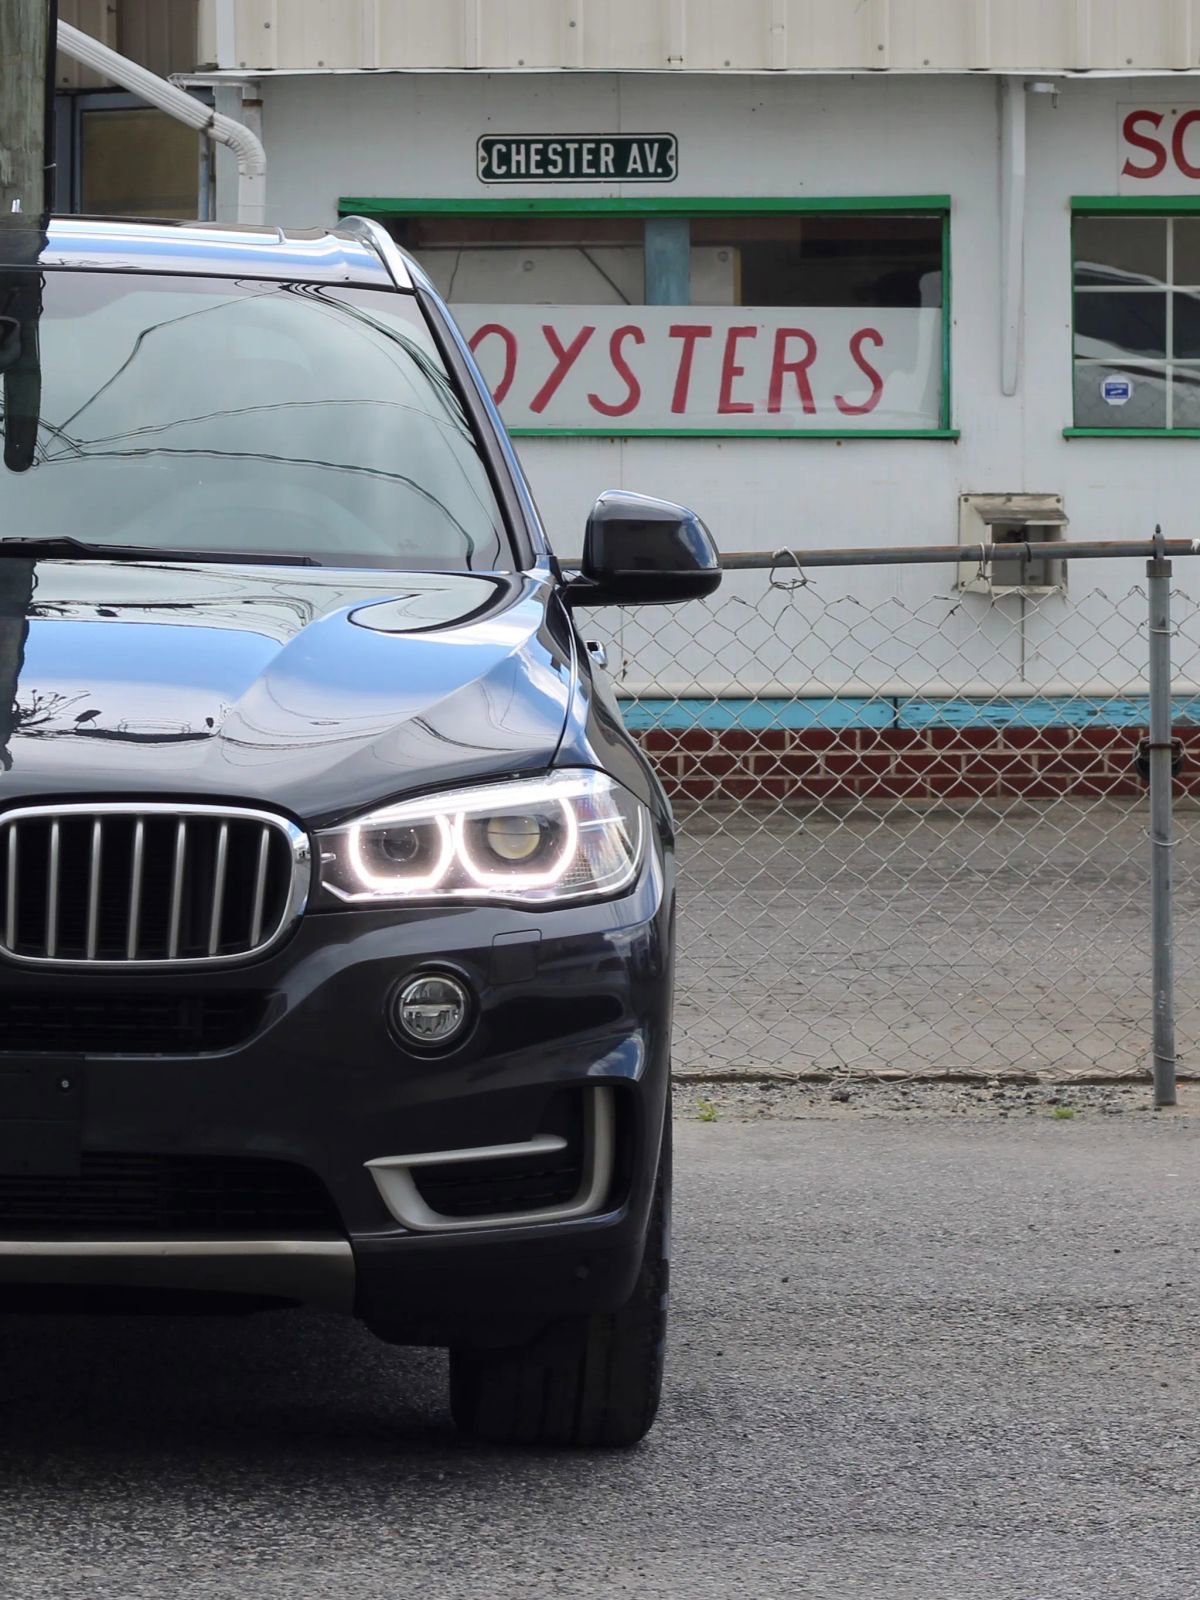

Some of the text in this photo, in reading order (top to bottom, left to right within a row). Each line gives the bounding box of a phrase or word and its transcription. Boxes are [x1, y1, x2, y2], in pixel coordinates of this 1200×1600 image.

[491, 142, 663, 175] CHESTER AV.
[468, 323, 884, 417] OYSTERS
